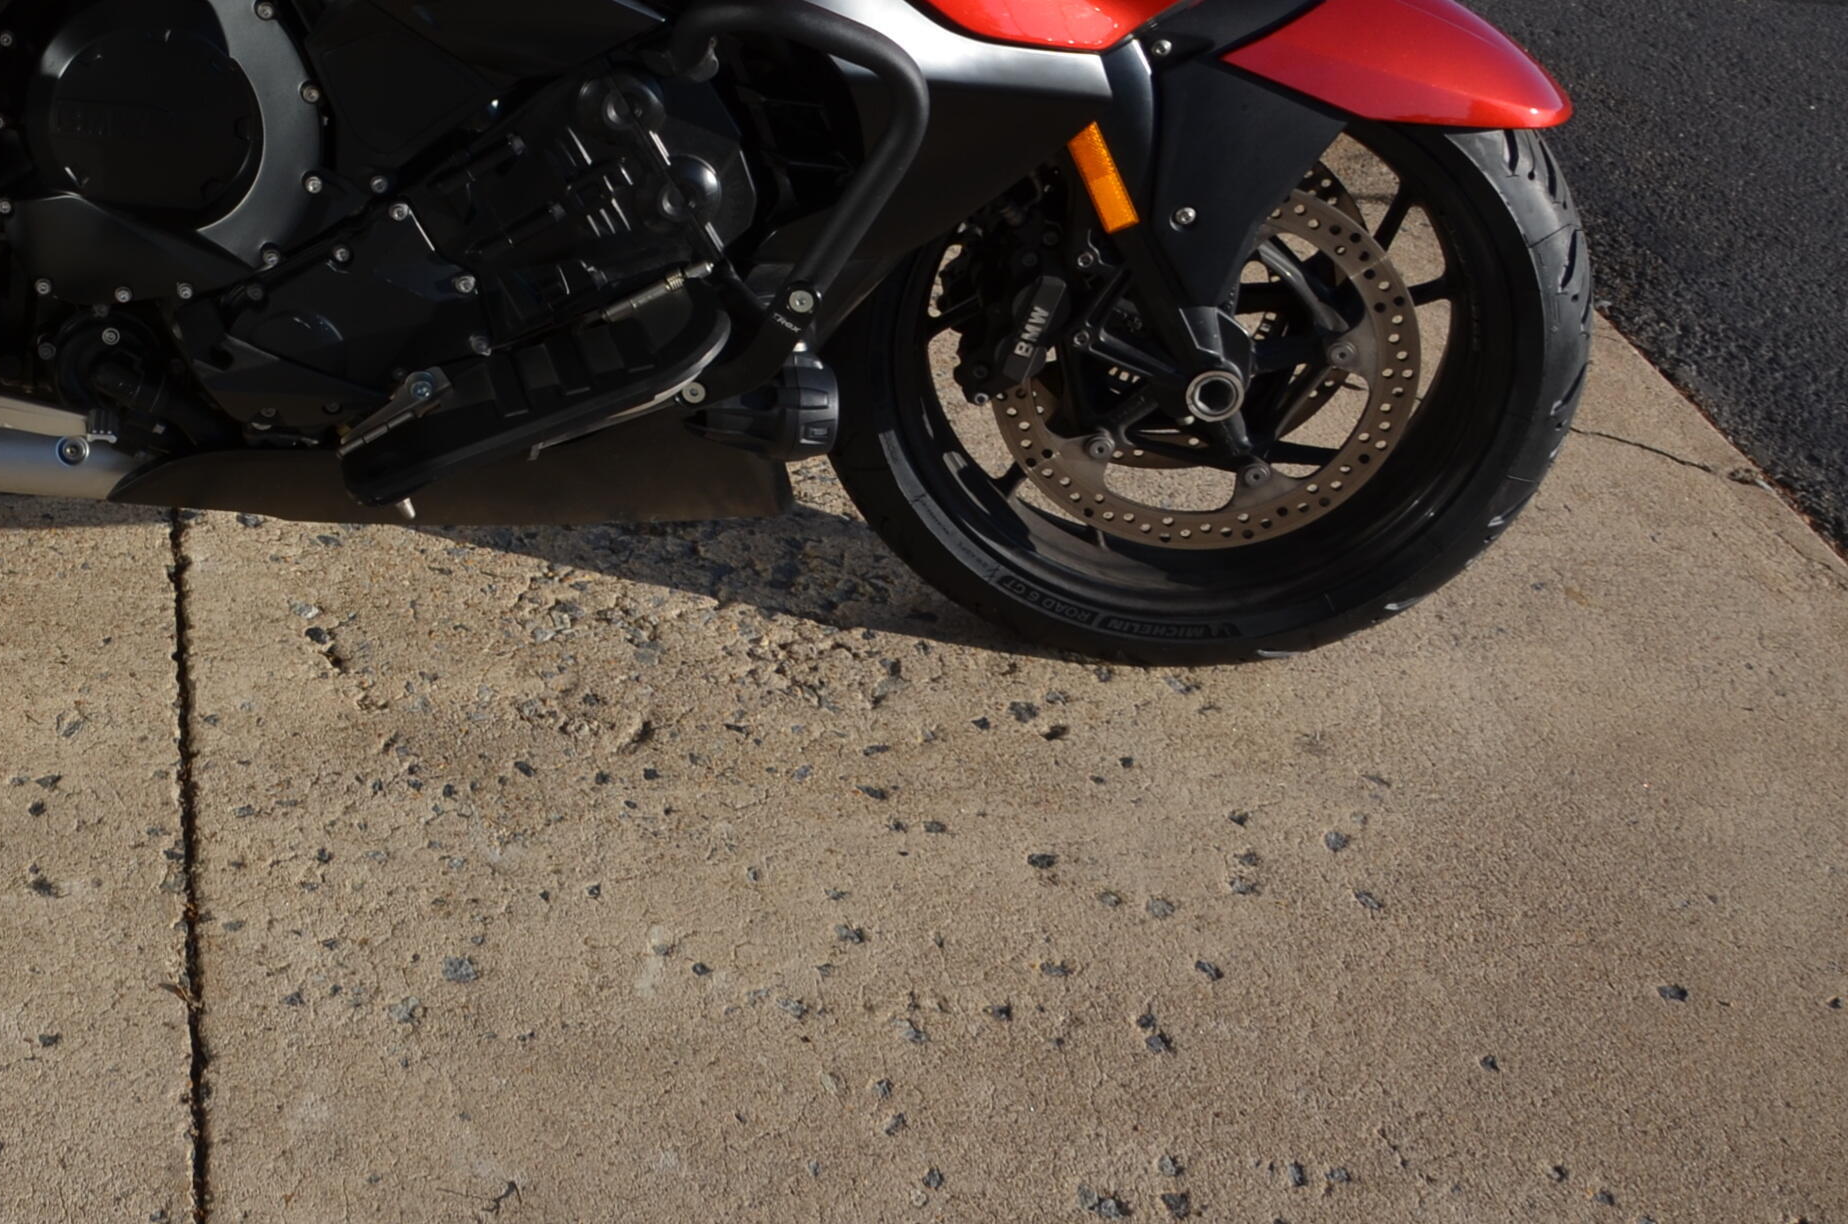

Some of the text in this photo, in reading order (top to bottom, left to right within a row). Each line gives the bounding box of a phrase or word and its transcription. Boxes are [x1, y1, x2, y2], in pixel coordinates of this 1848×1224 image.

[1013, 305, 1049, 358] BMW
[1003, 579, 1204, 637] MICHELIN ROAD 6 GT
